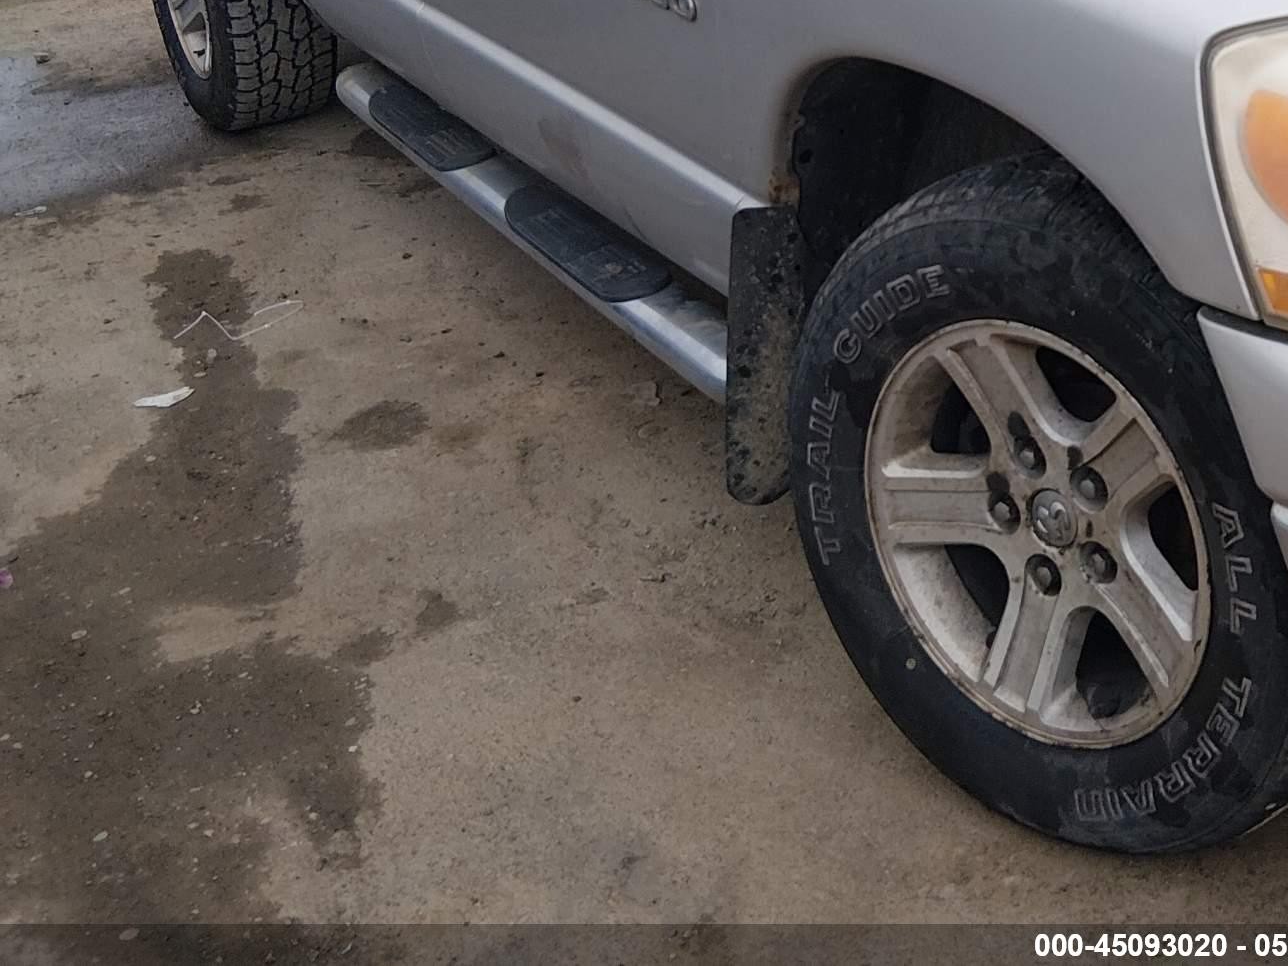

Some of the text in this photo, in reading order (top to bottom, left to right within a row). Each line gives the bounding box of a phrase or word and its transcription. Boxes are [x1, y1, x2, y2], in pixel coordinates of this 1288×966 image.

[806, 264, 950, 566] TRAIL GUIDE
[1074, 502, 1258, 822] ALL TERRAIN
